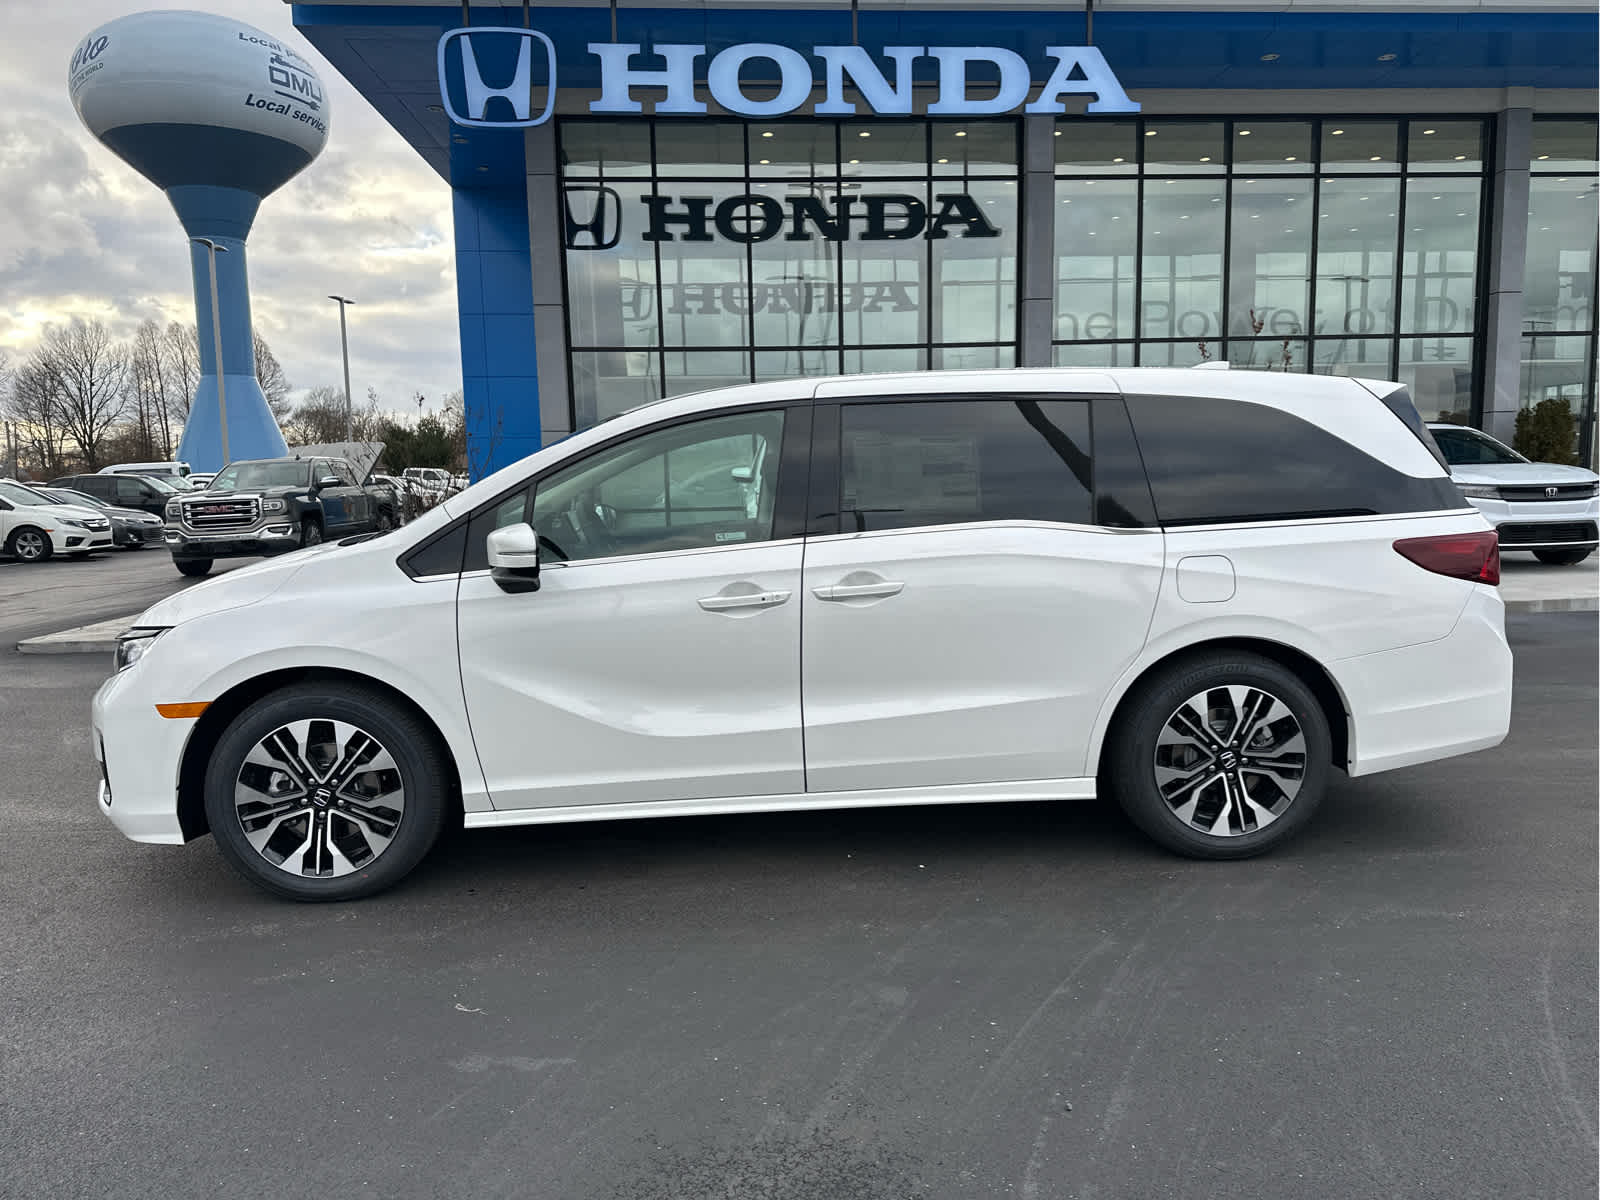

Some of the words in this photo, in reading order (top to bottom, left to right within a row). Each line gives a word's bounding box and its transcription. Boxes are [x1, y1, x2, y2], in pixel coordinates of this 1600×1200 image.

[239, 32, 281, 52] Local
[588, 43, 1141, 116] HONDA
[245, 94, 292, 115] Local
[641, 194, 1001, 243] HONDA
[204, 505, 235, 513] GMC
